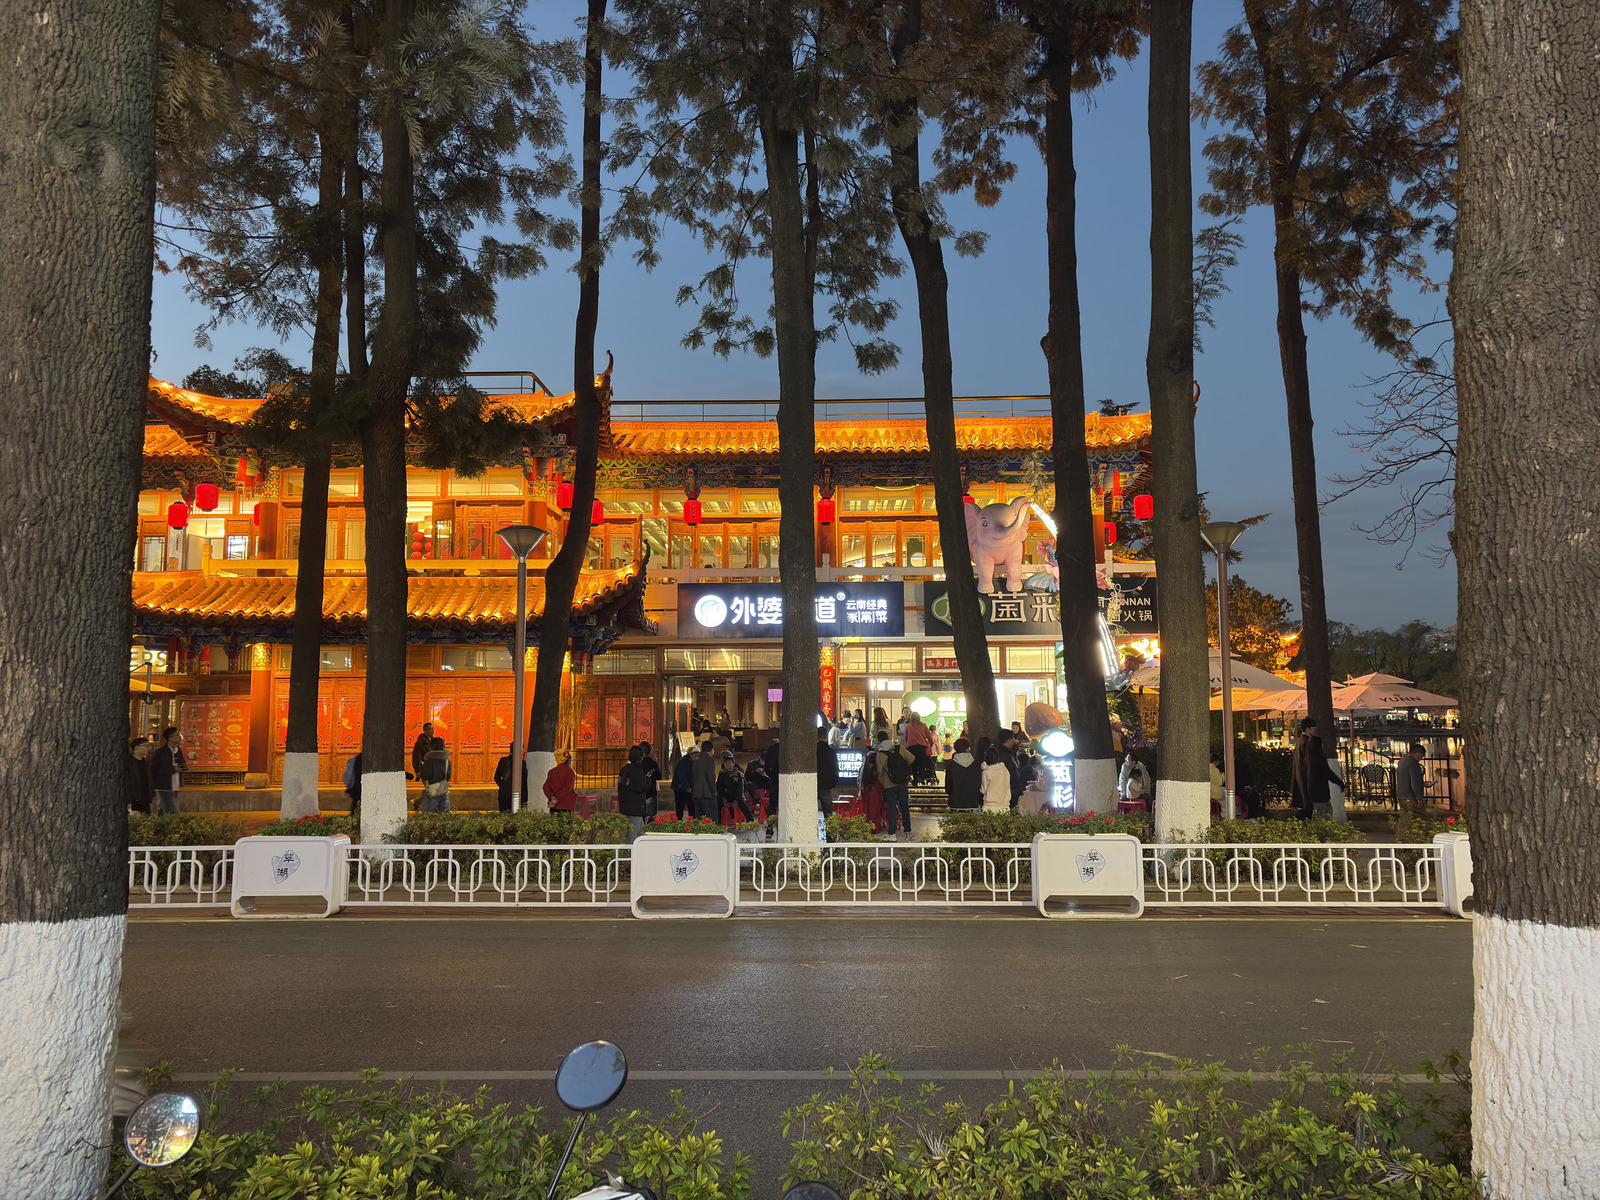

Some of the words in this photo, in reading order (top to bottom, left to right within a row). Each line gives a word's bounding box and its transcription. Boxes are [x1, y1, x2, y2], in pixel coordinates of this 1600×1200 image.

[730, 596, 837, 625] 外婆道
[846, 599, 888, 610] 云南经典
[277, 853, 295, 878] 翠湖
[675, 852, 693, 877] 翠湖
[1082, 852, 1099, 877] 翠湖
